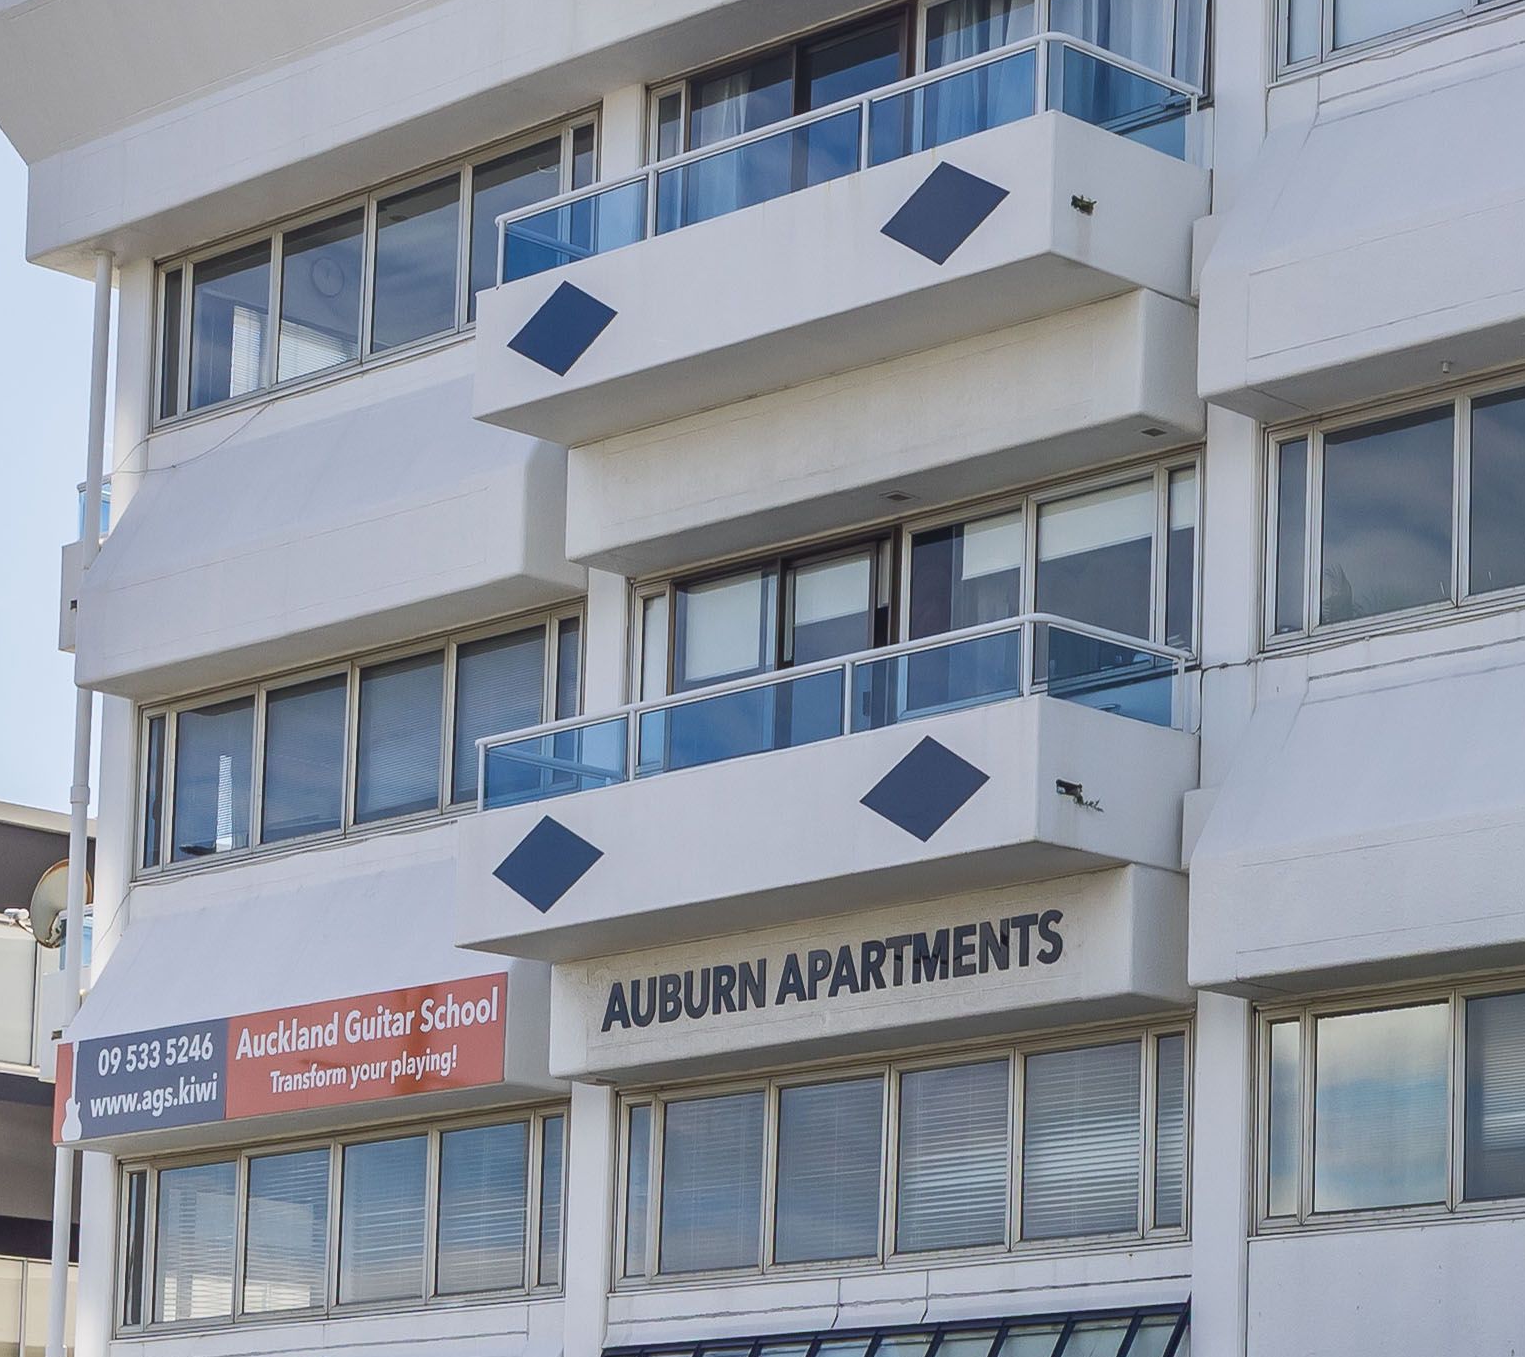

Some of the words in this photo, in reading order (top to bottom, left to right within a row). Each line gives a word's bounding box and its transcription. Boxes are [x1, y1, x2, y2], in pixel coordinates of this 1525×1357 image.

[602, 958, 766, 1032] AUBURN
[775, 909, 1064, 1005] APARTMENTS
[235, 1011, 339, 1060] Auckland
[344, 1000, 413, 1043] Guitar
[420, 986, 499, 1034] School
[97, 1047, 121, 1077] 09
[127, 1040, 161, 1071] 533
[165, 1032, 214, 1067] 5246
[270, 1062, 347, 1095] Transform
[351, 1059, 388, 1089] your
[391, 1051, 458, 1085] playing!
[90, 1072, 218, 1119] www.ags.kiwi
